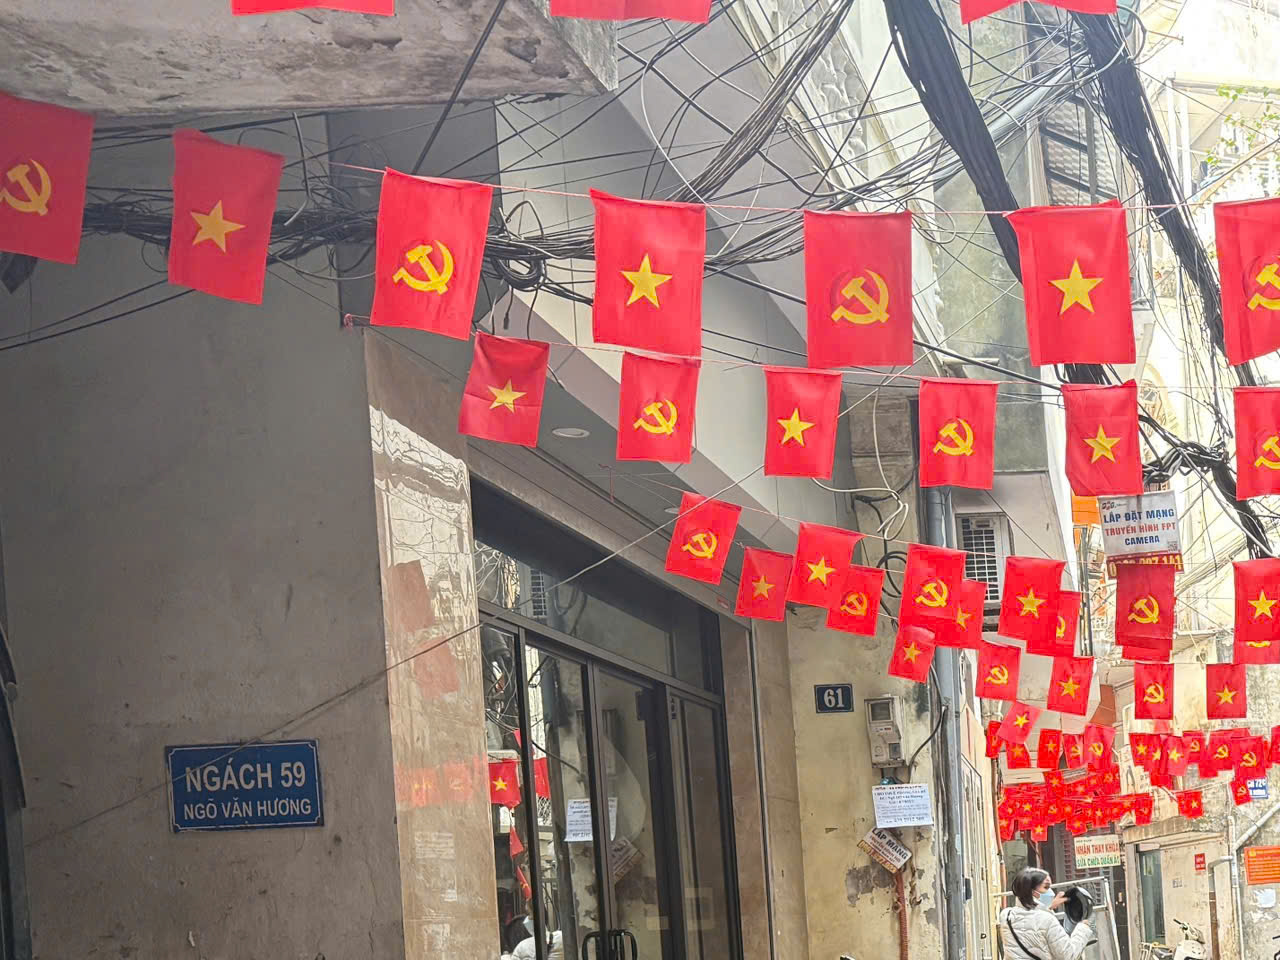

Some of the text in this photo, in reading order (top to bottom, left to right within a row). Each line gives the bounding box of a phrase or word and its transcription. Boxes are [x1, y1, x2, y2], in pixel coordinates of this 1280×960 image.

[1103, 508, 1175, 524] LẮP ĐẶT MẠNG
[1105, 522, 1176, 537] TRUYỀN HÌNH FPT
[1124, 535, 1160, 546] CAMERA
[823, 687, 845, 708] 61
[185, 757, 306, 792] NGÁCH 59
[183, 797, 312, 820] NGÕ VĂN HƯƠNG
